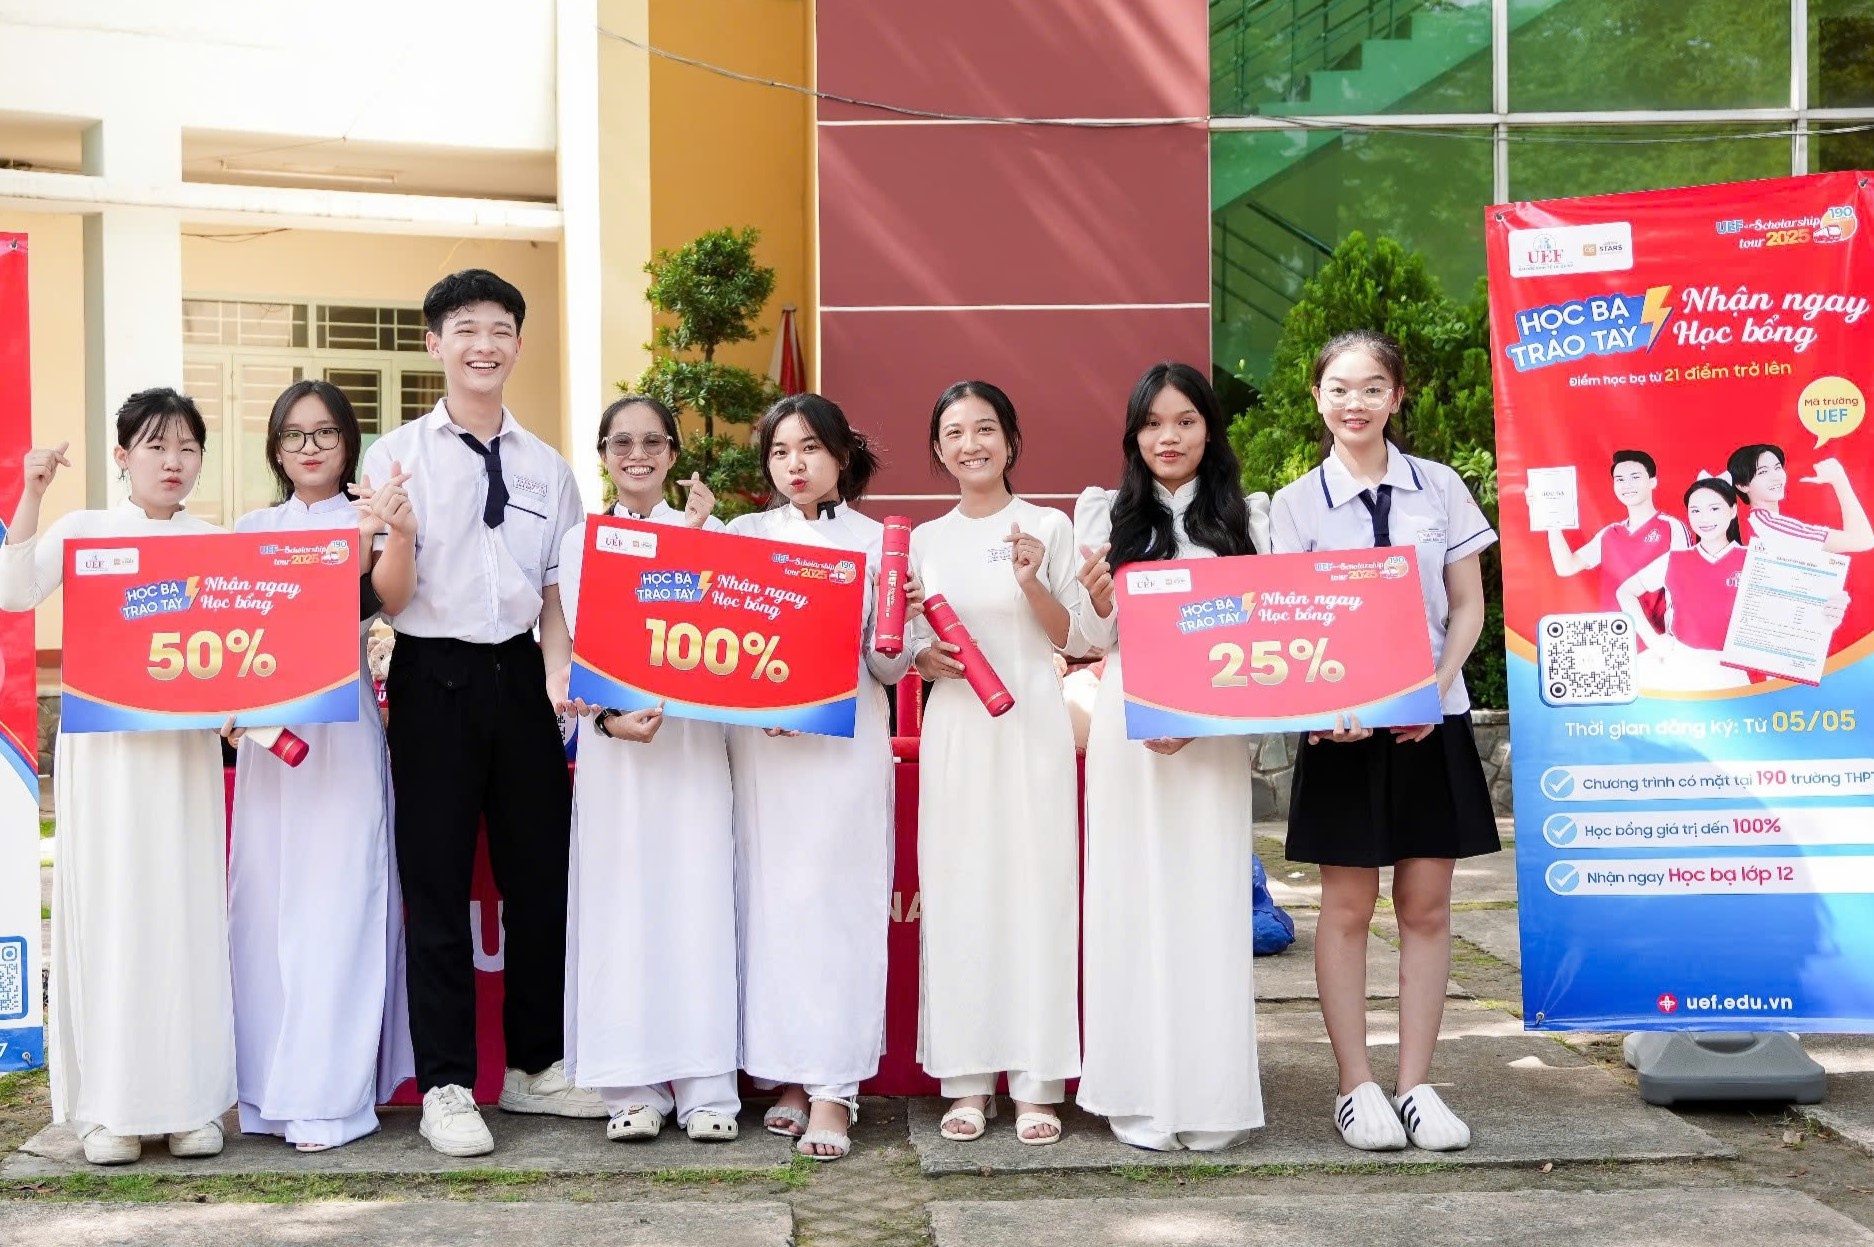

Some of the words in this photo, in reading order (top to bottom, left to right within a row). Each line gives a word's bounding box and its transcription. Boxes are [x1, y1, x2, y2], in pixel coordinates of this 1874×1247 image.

[1829, 206, 1853, 218] 190
[1716, 220, 1743, 234] UEF
[1739, 237, 1765, 249] tour
[1766, 229, 1811, 247] 2025
[1528, 249, 1564, 264] UEF
[1682, 286, 1773, 317] Nhận
[1782, 292, 1870, 323] ngay
[1521, 304, 1586, 335] HỌC
[1591, 298, 1630, 325] BẠ
[1673, 320, 1733, 350] Học
[1741, 314, 1818, 353] bổng
[1511, 335, 1587, 367] TRAO
[1591, 325, 1637, 351] TAY
[1603, 375, 1627, 387] học
[1630, 373, 1646, 386] bạ
[1665, 369, 1680, 382] 21
[1685, 362, 1729, 380] điểm
[1734, 361, 1760, 377] trở
[1764, 360, 1792, 376] lên
[1823, 396, 1859, 407] trường
[1816, 408, 1848, 422] UEF
[260, 545, 279, 554] UEF
[274, 558, 291, 566] tour
[291, 554, 320, 565] 2025
[1389, 556, 1404, 564] 190
[642, 573, 672, 587] HỌC
[675, 573, 692, 587] BẠ
[785, 568, 800, 576] tour
[801, 567, 828, 579] 2025
[127, 586, 158, 603] HỌC
[160, 582, 180, 597] BẠ
[204, 576, 251, 595] Nhận
[255, 581, 301, 599] ngay
[637, 589, 671, 600] TRAO
[674, 588, 695, 600] TAY
[717, 574, 761, 595] Nhận
[765, 585, 808, 610] ngay
[123, 602, 158, 619] TRAO
[160, 598, 184, 611] TAY
[200, 594, 230, 612] Học
[234, 593, 273, 615] bổng
[711, 590, 740, 609] Học
[744, 596, 781, 620] bổng
[1182, 602, 1214, 618] HỌC
[1216, 598, 1235, 613] BẠ
[1260, 592, 1309, 608] Nhận
[1314, 595, 1363, 611] ngay
[1179, 617, 1215, 632] TRAO
[1217, 611, 1240, 625] TAY
[1258, 609, 1290, 625] Học
[1295, 605, 1336, 627] bổng
[147, 628, 277, 681] 50%
[645, 617, 789, 683] 100%
[1208, 637, 1345, 688] 25%
[1565, 720, 1604, 737] Thời
[1609, 720, 1650, 740] gian
[1710, 719, 1739, 738] ký:
[1744, 717, 1767, 734] Từ
[1772, 709, 1857, 732] 05/05
[1583, 778, 1638, 791] Chương
[1643, 776, 1675, 788] trình
[1678, 774, 1697, 788] có
[1700, 775, 1730, 790] mặt
[1734, 773, 1752, 789] tại
[1756, 770, 1787, 786] 190
[1791, 773, 1841, 787] trường
[1585, 825, 1612, 839] Học
[1616, 821, 1653, 839] bổng
[1656, 823, 1679, 839] giá
[1682, 822, 1698, 837] trị
[1733, 817, 1782, 834] 100%
[1587, 871, 1625, 887] Nhận
[1628, 873, 1665, 887] ngay
[1669, 867, 1706, 887] Học
[1710, 867, 1737, 886] bạ
[1741, 865, 1772, 886] lớp
[1777, 866, 1794, 881] 12
[1686, 994, 1793, 1010] uef.edu.vn
